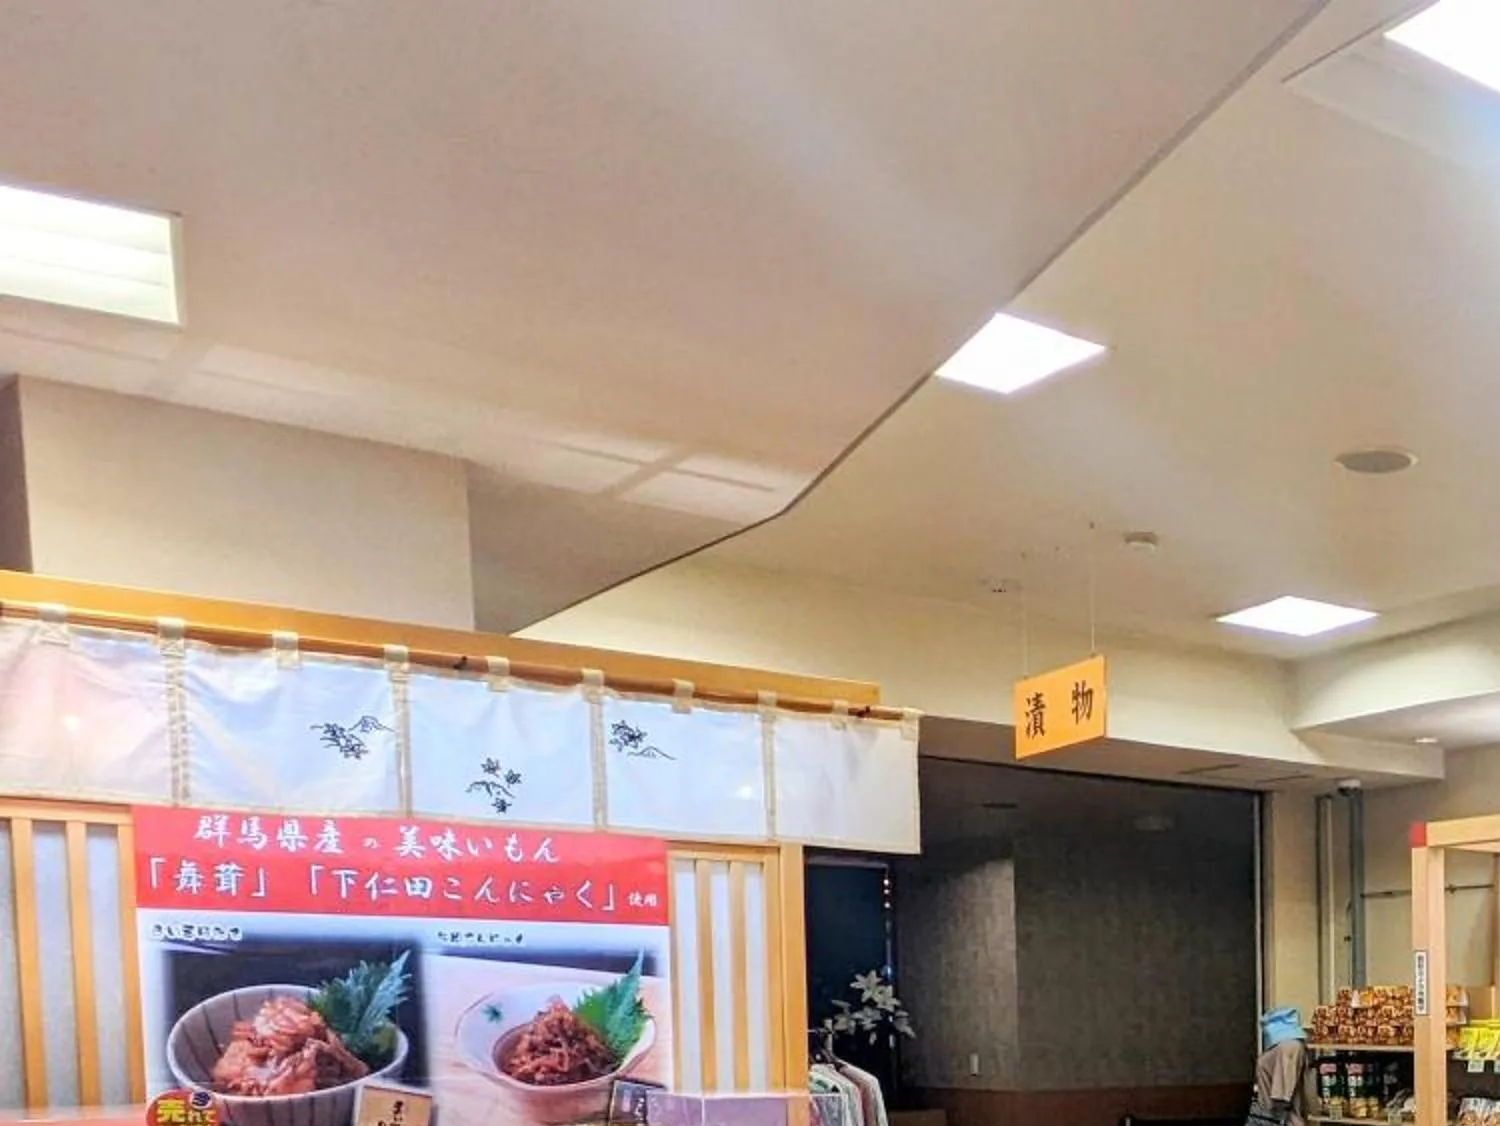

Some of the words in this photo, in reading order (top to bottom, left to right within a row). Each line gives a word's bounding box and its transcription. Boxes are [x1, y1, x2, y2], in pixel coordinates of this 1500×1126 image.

[1025, 680, 1093, 739] 漬物
[195, 815, 561, 864] 群馬県産の美味いもん
[308, 865, 615, 911] 「下仁田こんにゃく」
